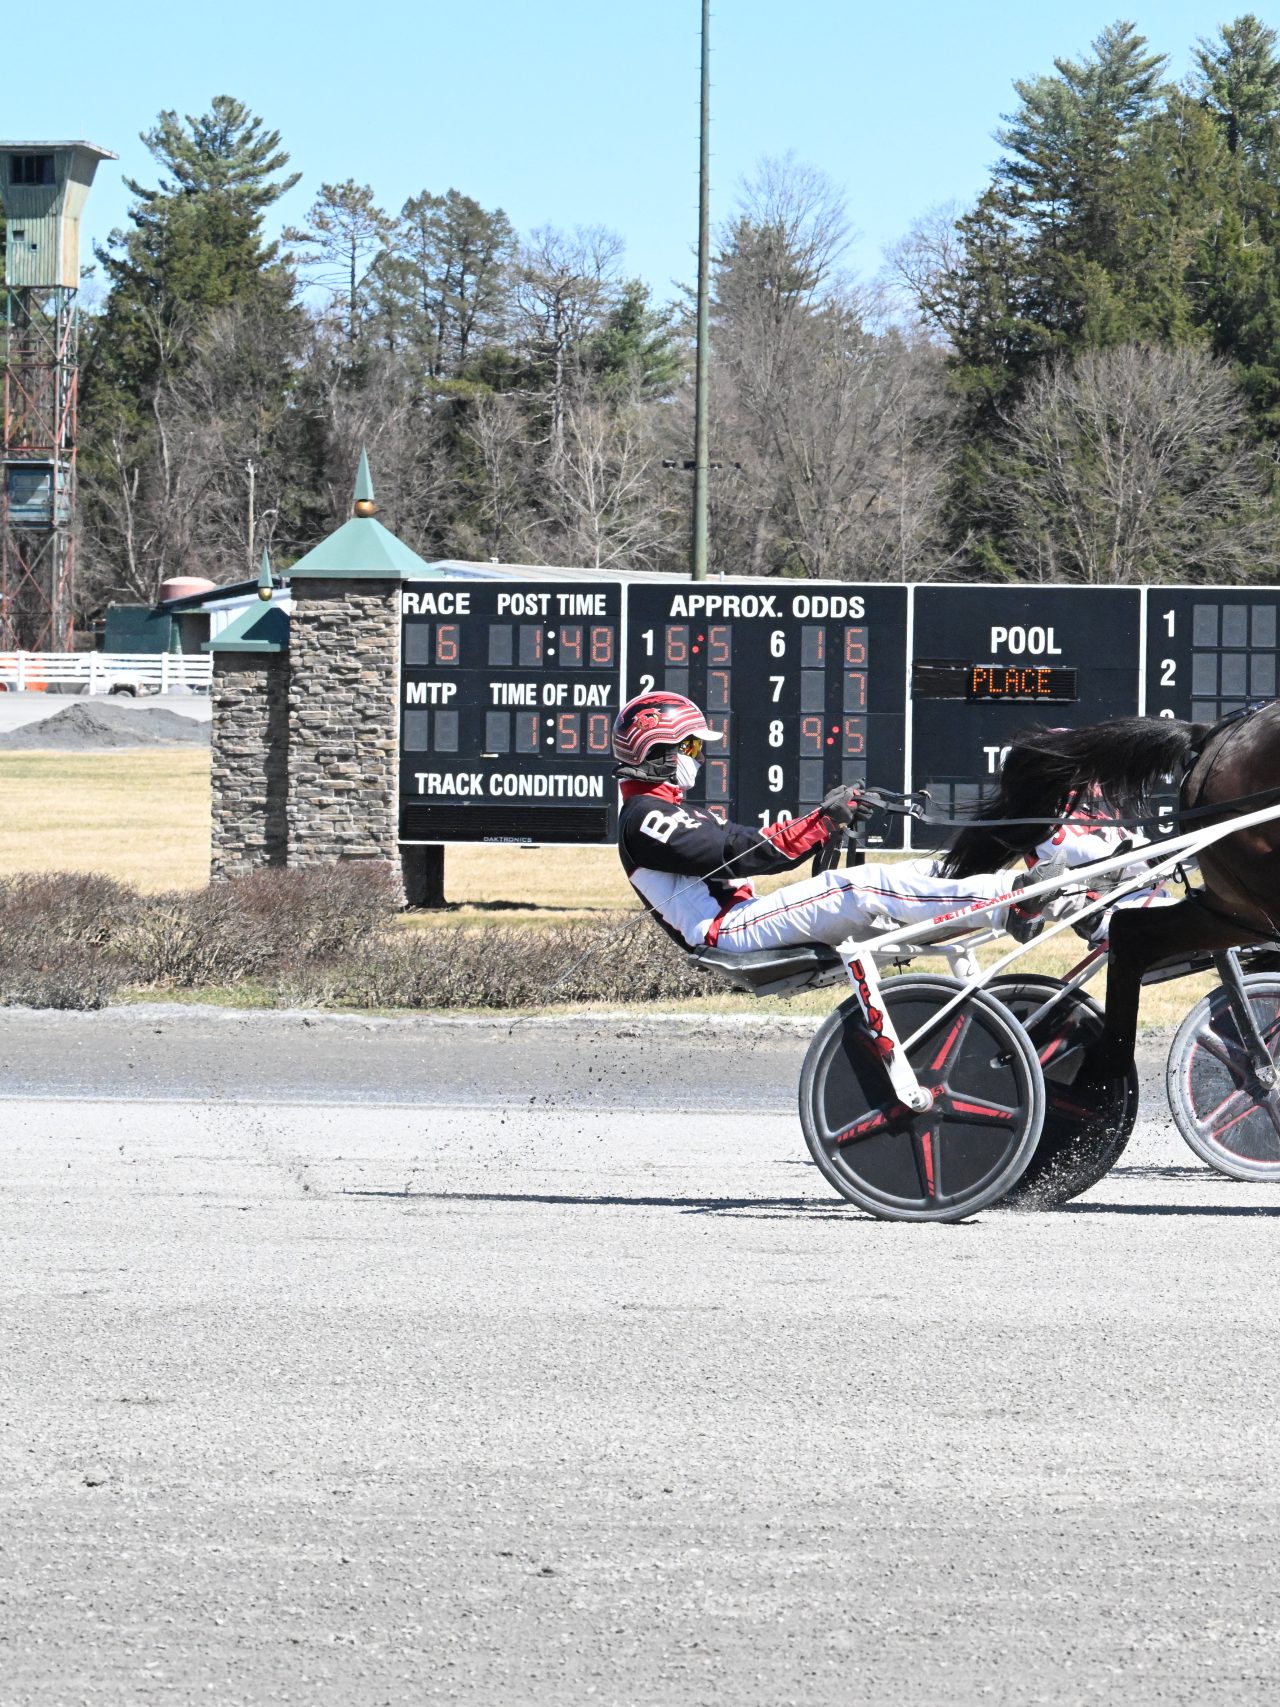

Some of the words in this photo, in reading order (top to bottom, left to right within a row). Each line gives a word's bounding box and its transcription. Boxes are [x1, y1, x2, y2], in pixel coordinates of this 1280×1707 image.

[402, 592, 471, 615] RACE
[497, 593, 551, 616] POST
[556, 594, 607, 616] TIME
[669, 595, 783, 618] APPROX.
[792, 596, 865, 618] ODDS
[1162, 609, 1176, 638] 1
[437, 625, 458, 661] 6
[641, 629, 654, 656] 1
[770, 630, 786, 658] 6
[990, 626, 1062, 655] POOL
[639, 674, 655, 696] 2
[972, 667, 1052, 693] PLACE
[1160, 658, 1177, 687] 2
[406, 682, 457, 704] MTP
[489, 682, 537, 705] TIME
[542, 683, 568, 706] OF
[573, 684, 612, 706] DAY
[769, 675, 785, 702] 7
[848, 673, 865, 706] 7
[769, 719, 784, 747] 8
[414, 772, 484, 796] TRACK
[489, 773, 604, 798] CONDITION
[768, 765, 784, 792] 9
